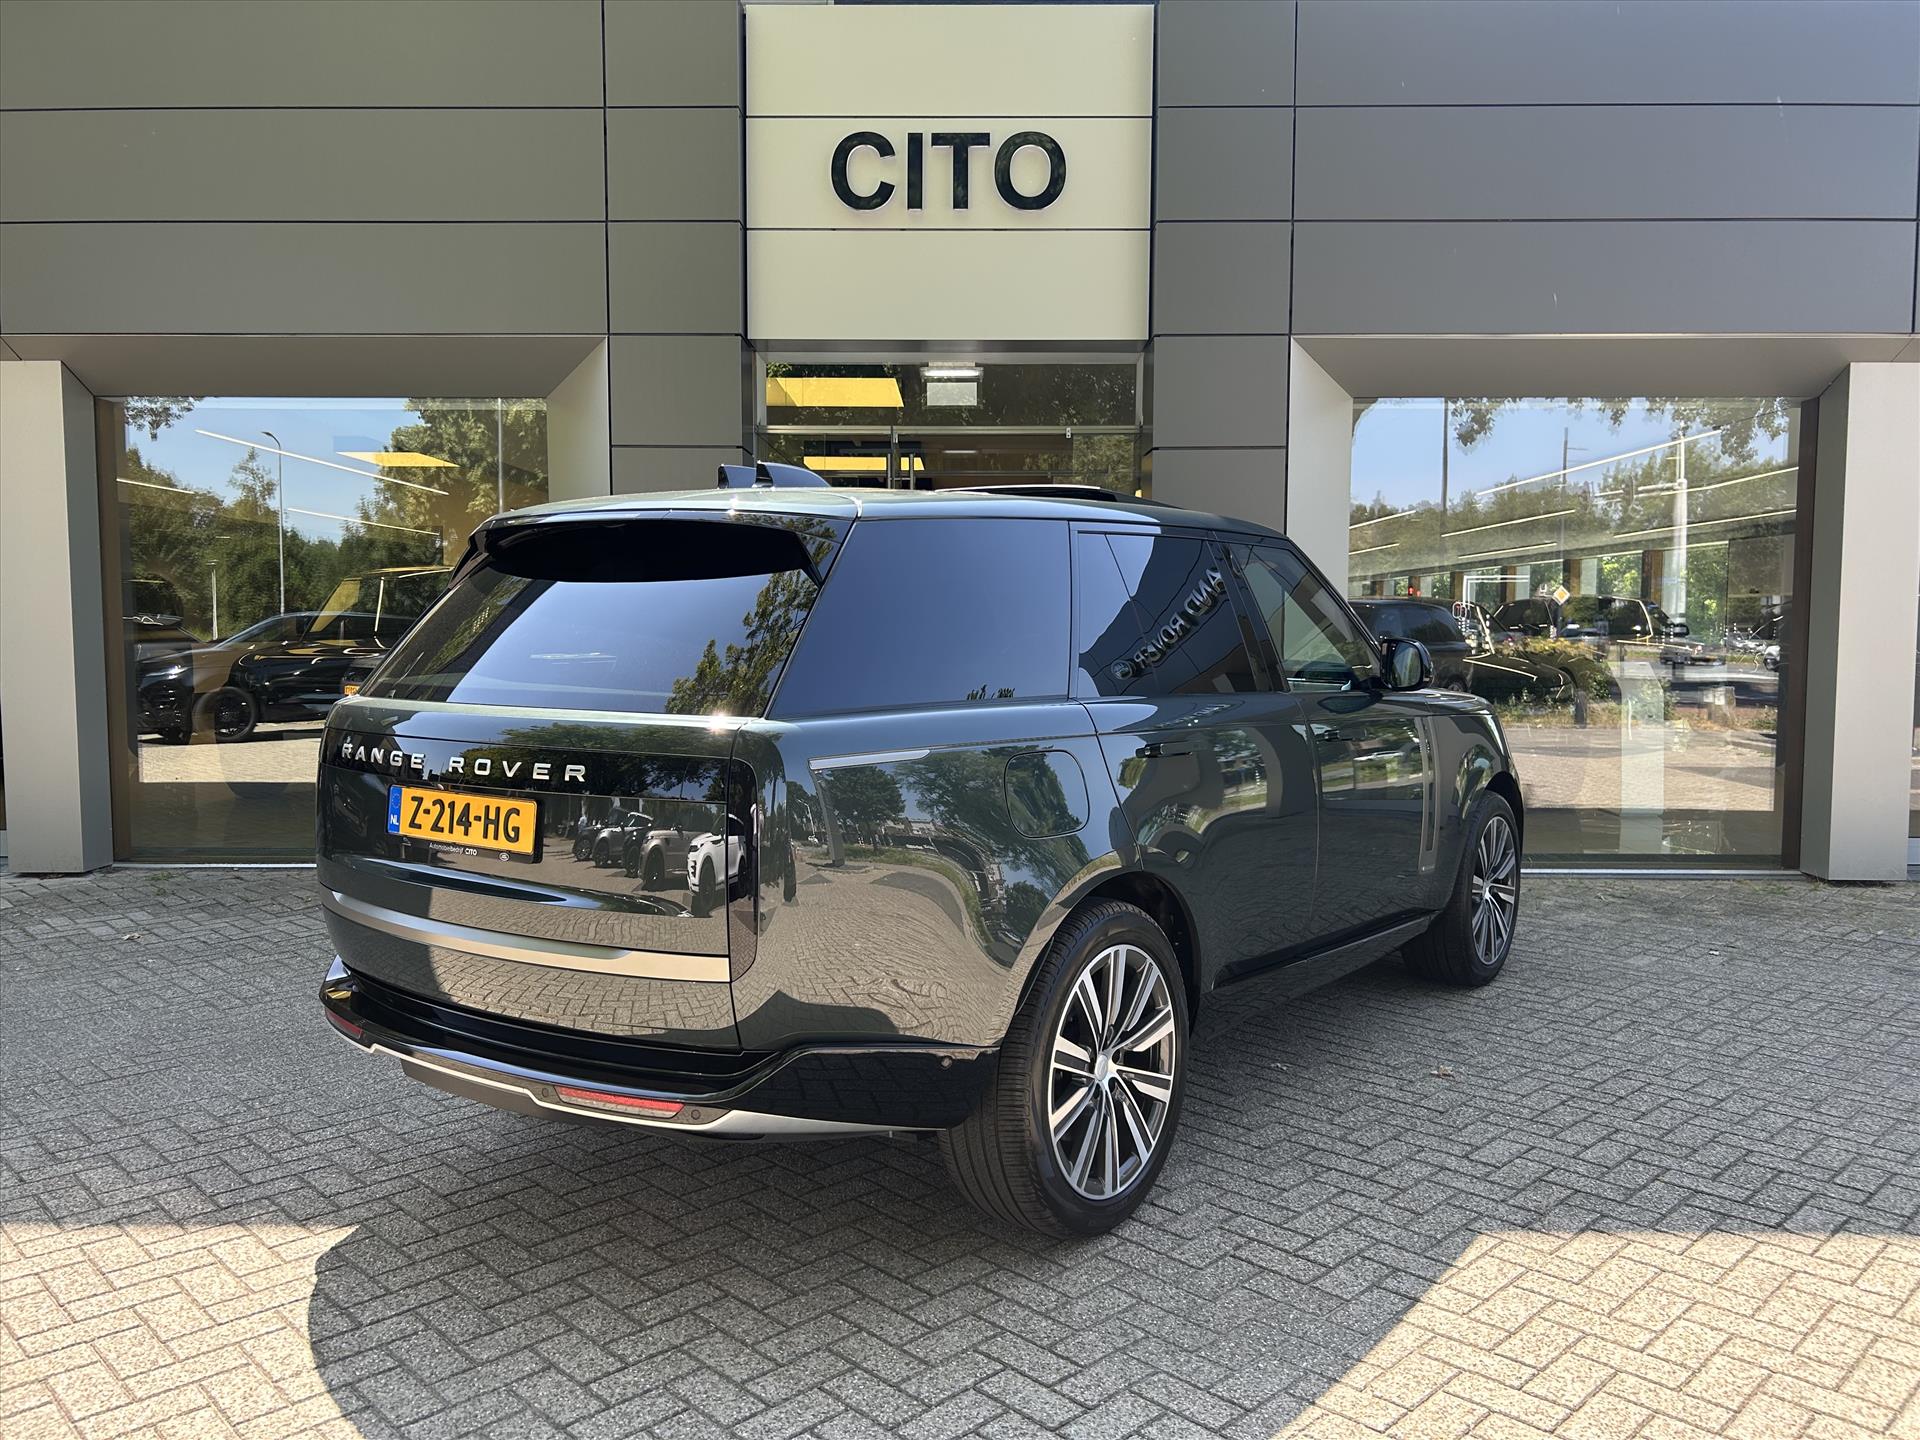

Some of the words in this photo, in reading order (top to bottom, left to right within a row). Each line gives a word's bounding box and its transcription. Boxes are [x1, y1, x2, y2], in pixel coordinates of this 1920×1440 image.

[831, 131, 1067, 210] CITO
[341, 742, 425, 769] RANGE
[448, 756, 586, 782] ROVER
[390, 814, 399, 826] NL
[408, 795, 521, 843] Z-214-HG
[464, 847, 478, 856] CITO
